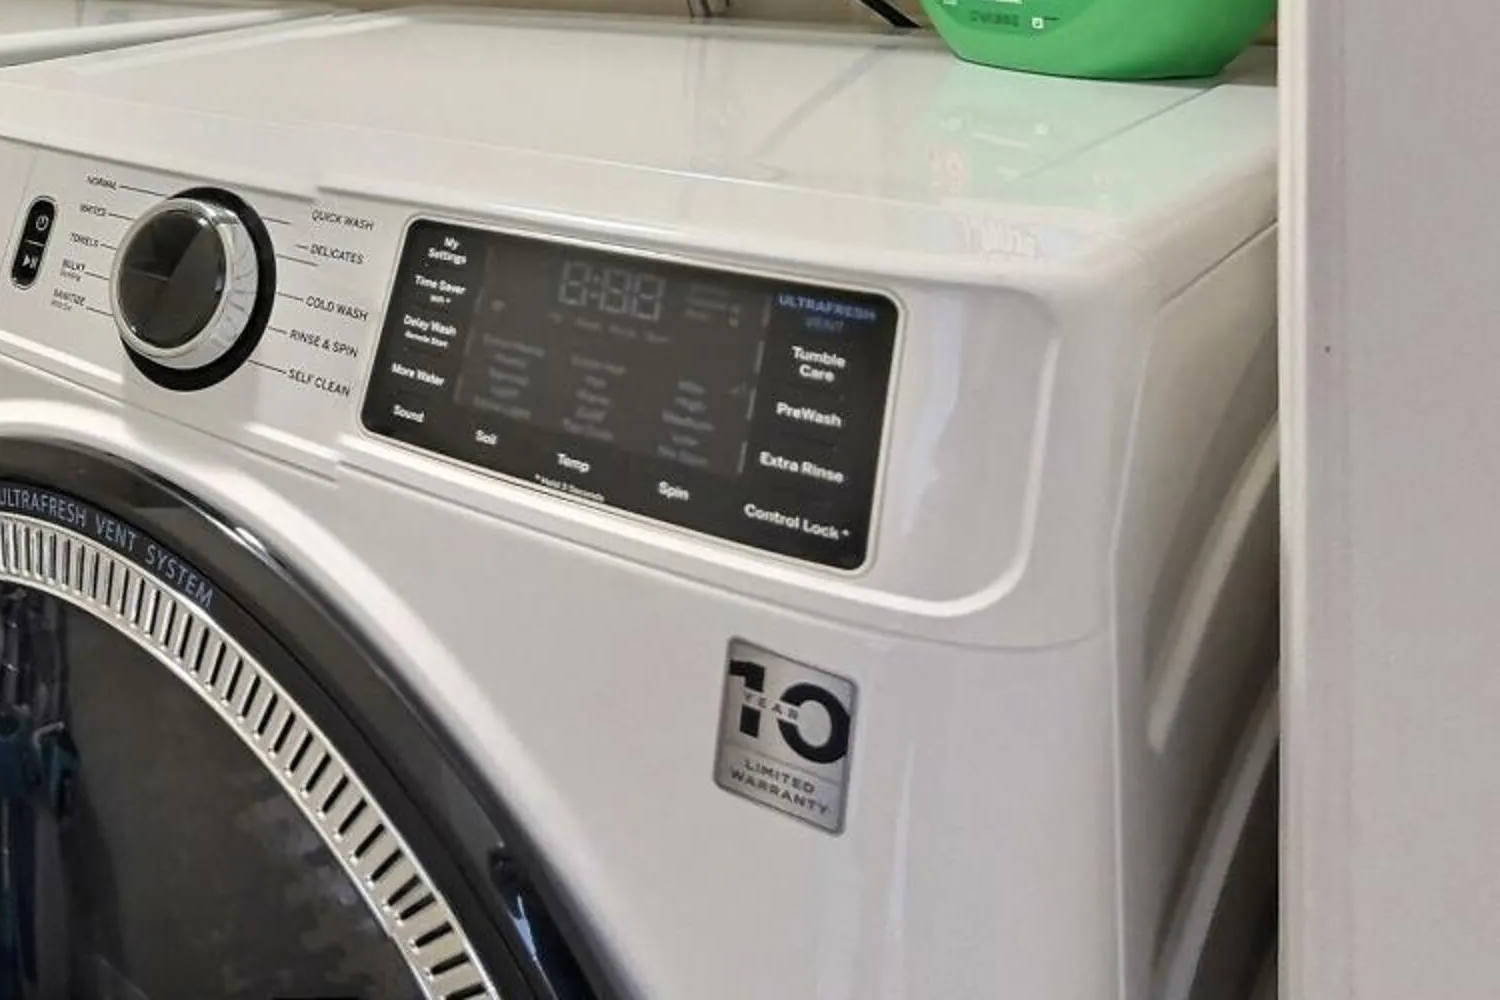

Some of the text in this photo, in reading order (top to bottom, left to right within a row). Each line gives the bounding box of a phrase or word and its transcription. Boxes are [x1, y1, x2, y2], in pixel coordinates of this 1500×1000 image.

[311, 209, 375, 231] QUICK WASH
[310, 243, 364, 265] DELICATES
[428, 247, 468, 266] Settings
[414, 274, 467, 295] Time Saver
[305, 295, 368, 322] COLD WASH
[778, 293, 877, 321] ULTRAFRESH
[403, 314, 457, 337] Delay Wash
[289, 329, 358, 358] RINSE & SPIN
[792, 345, 846, 368] Tumble
[288, 368, 350, 397] SELF CLEAN
[391, 362, 445, 387] More Water
[799, 363, 836, 383] Care
[393, 403, 425, 423] Sound
[775, 401, 843, 428] PreWash
[474, 428, 498, 446] Soil
[557, 452, 591, 473] Temp
[759, 450, 845, 484] Extra Rinse
[658, 481, 690, 501] Spin
[743, 503, 800, 530] Control
[95, 515, 137, 552] VENT
[145, 543, 216, 611] SYSTEM
[729, 659, 852, 765] 10
[744, 758, 816, 795] LIMITED
[731, 769, 829, 816] WARRANTY
